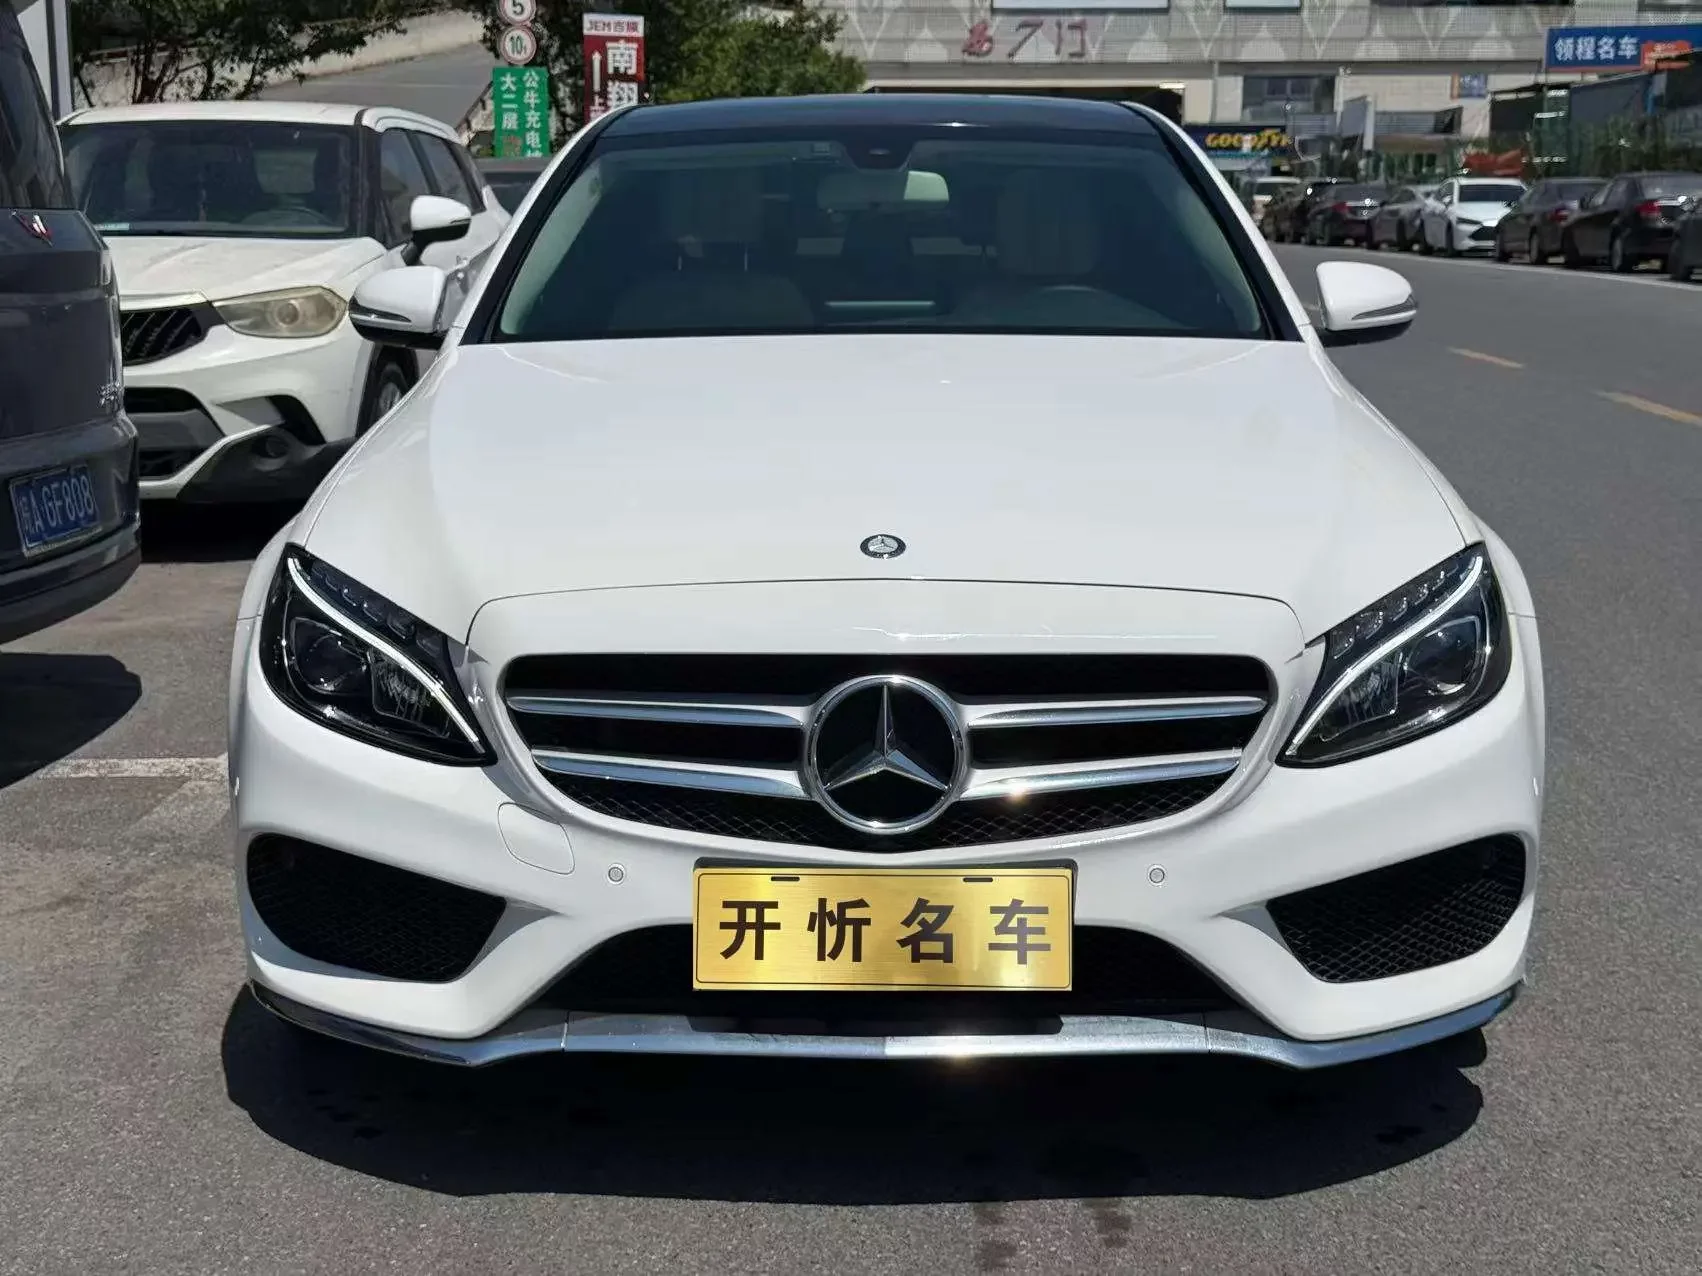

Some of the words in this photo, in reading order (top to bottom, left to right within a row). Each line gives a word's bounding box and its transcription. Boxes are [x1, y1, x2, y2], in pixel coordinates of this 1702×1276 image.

[512, 0, 524, 15] 5
[718, 896, 1052, 965] 开忻名车
